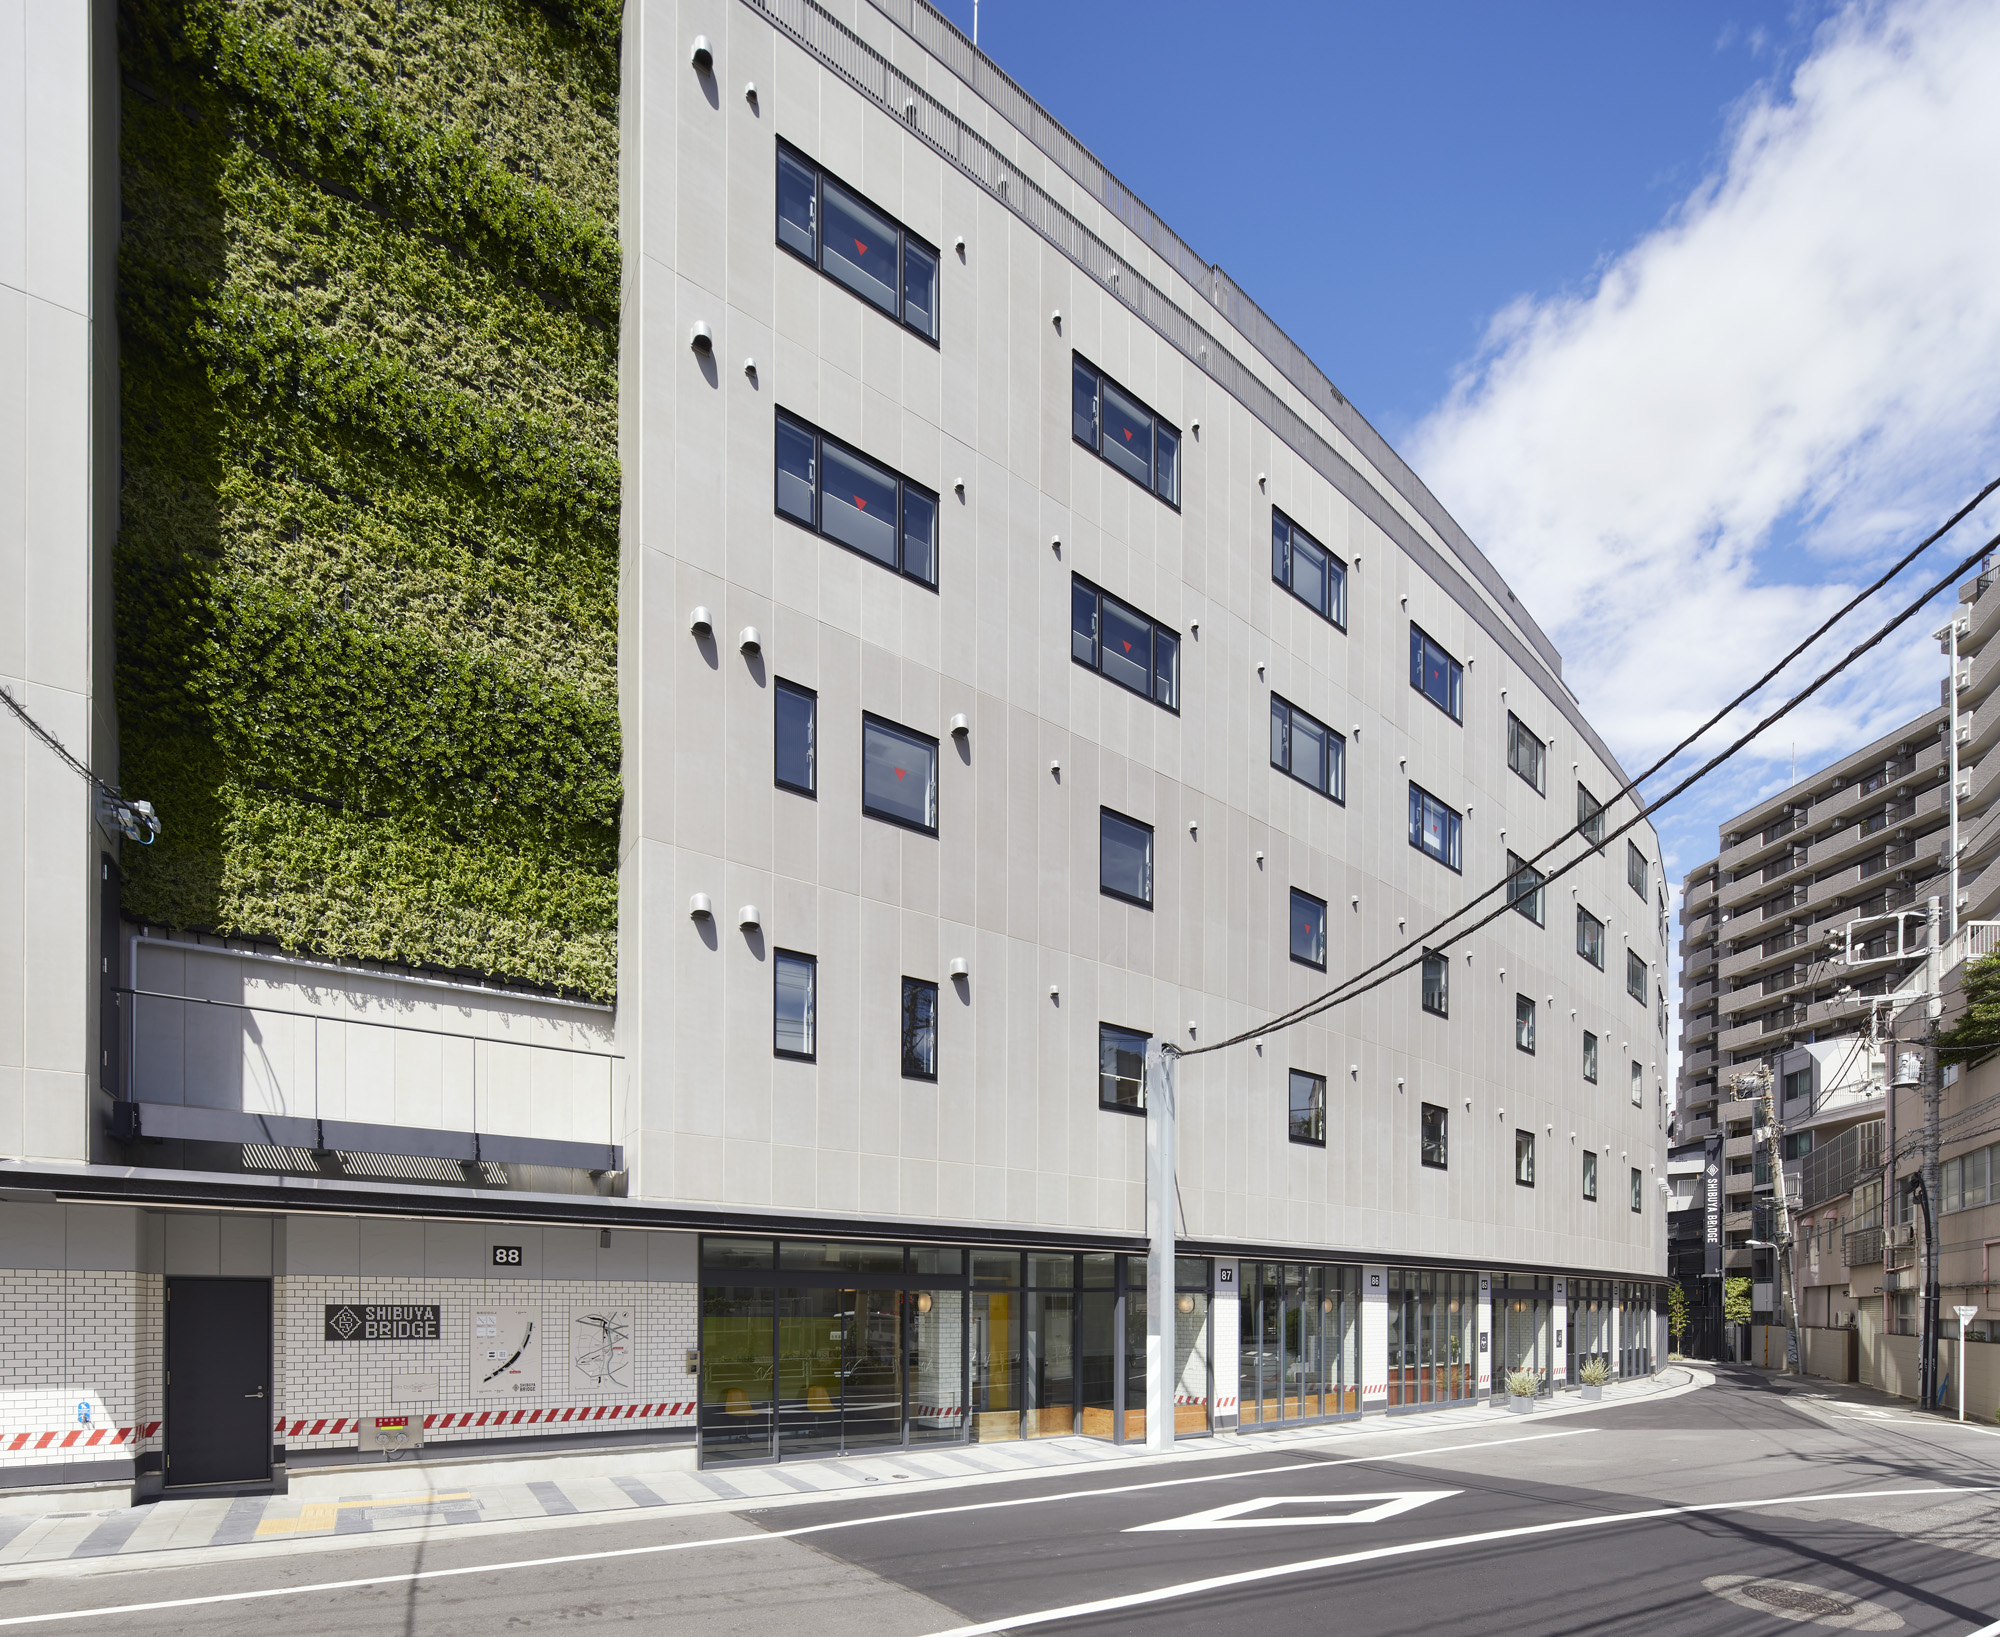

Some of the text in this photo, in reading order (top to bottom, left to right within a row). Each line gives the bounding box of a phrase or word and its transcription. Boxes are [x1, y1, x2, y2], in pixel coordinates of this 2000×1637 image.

[1707, 1178, 1718, 1243] SHIBUYA BRIDGE
[495, 1248, 520, 1263] 88
[1221, 1270, 1232, 1281] 87
[1371, 1276, 1379, 1285] 86
[365, 1306, 434, 1320] SHIBUYA
[365, 1321, 437, 1339] BRIDGE
